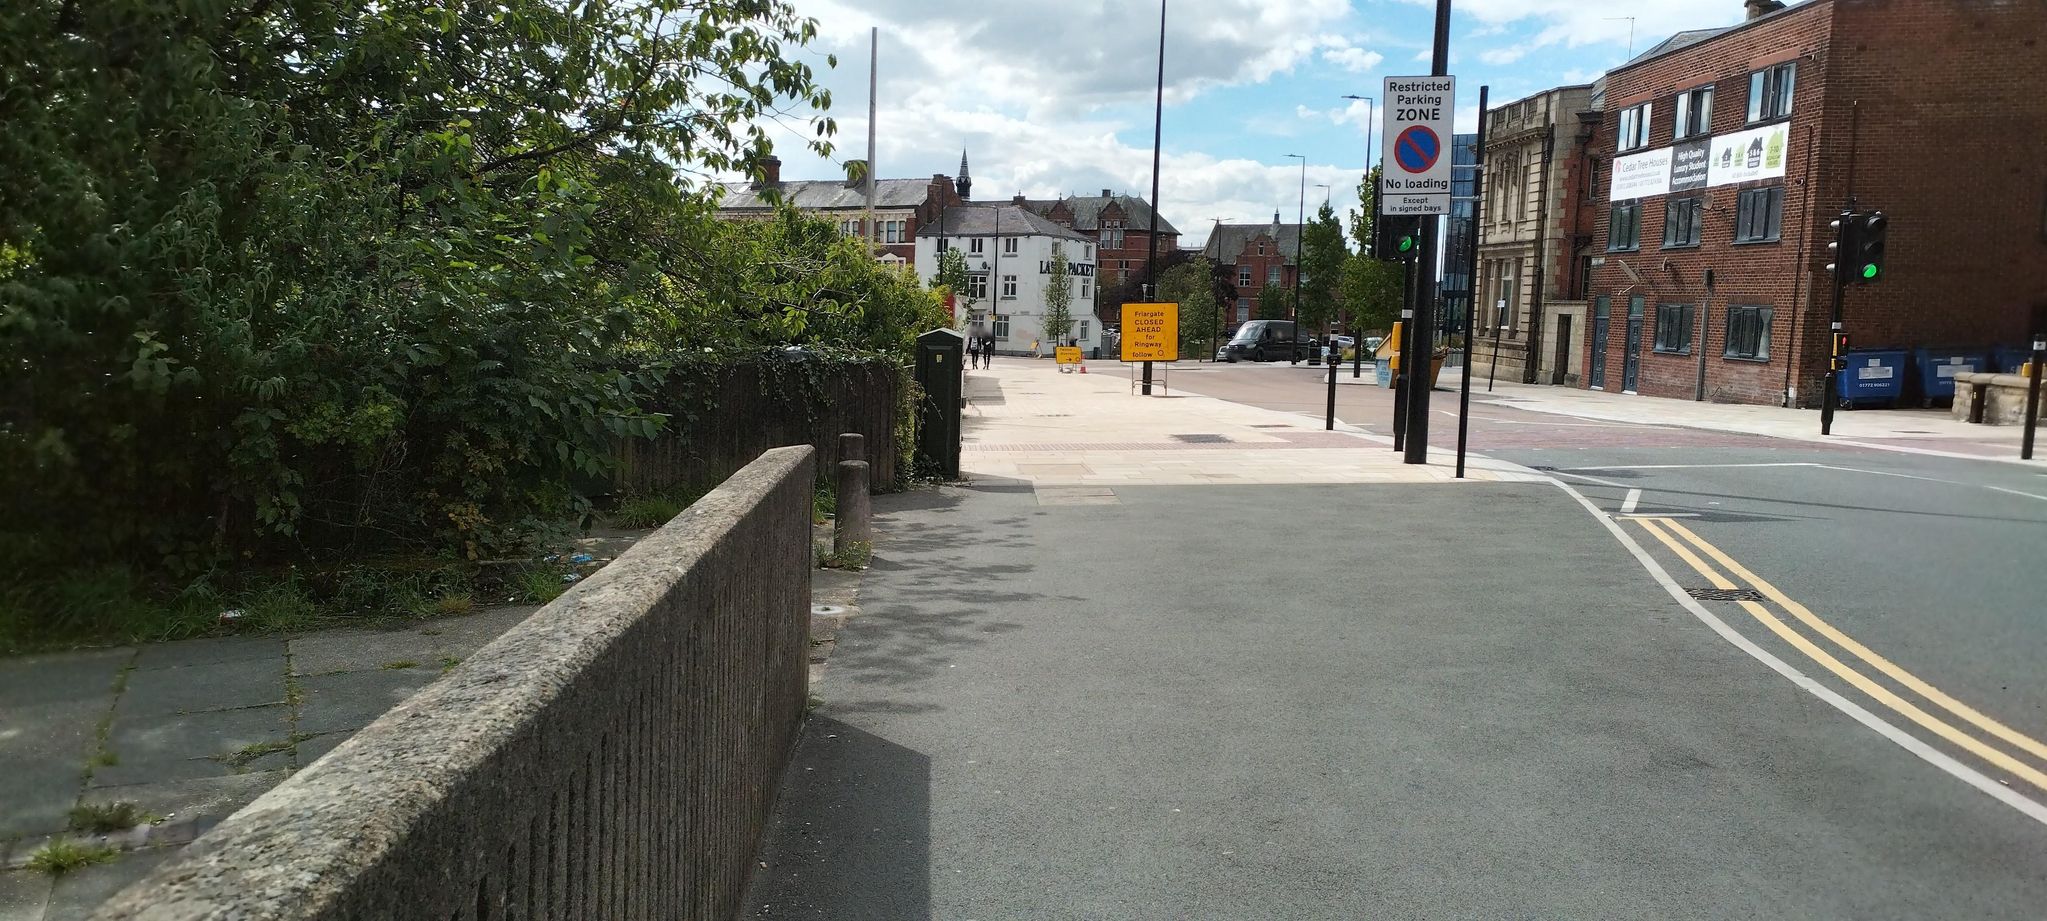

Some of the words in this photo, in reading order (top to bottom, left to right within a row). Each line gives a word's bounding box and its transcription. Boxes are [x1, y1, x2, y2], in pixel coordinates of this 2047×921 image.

[1389, 81, 1450, 92] Restricted
[1397, 94, 1442, 106] Parking
[1396, 108, 1440, 121] ZONE
[1677, 150, 1688, 162] High
[1689, 148, 1705, 160] Quality
[1622, 161, 1636, 172] Cedar
[1637, 159, 1648, 170] Tree
[1649, 156, 1669, 168] Houses
[1674, 164, 1688, 174] Luxury
[1689, 160, 1706, 170] Student
[1385, 179, 1401, 189] No
[1405, 178, 1448, 189] loading
[1672, 172, 1706, 185] Accommodation
[1068, 262, 1095, 277] PACKET
